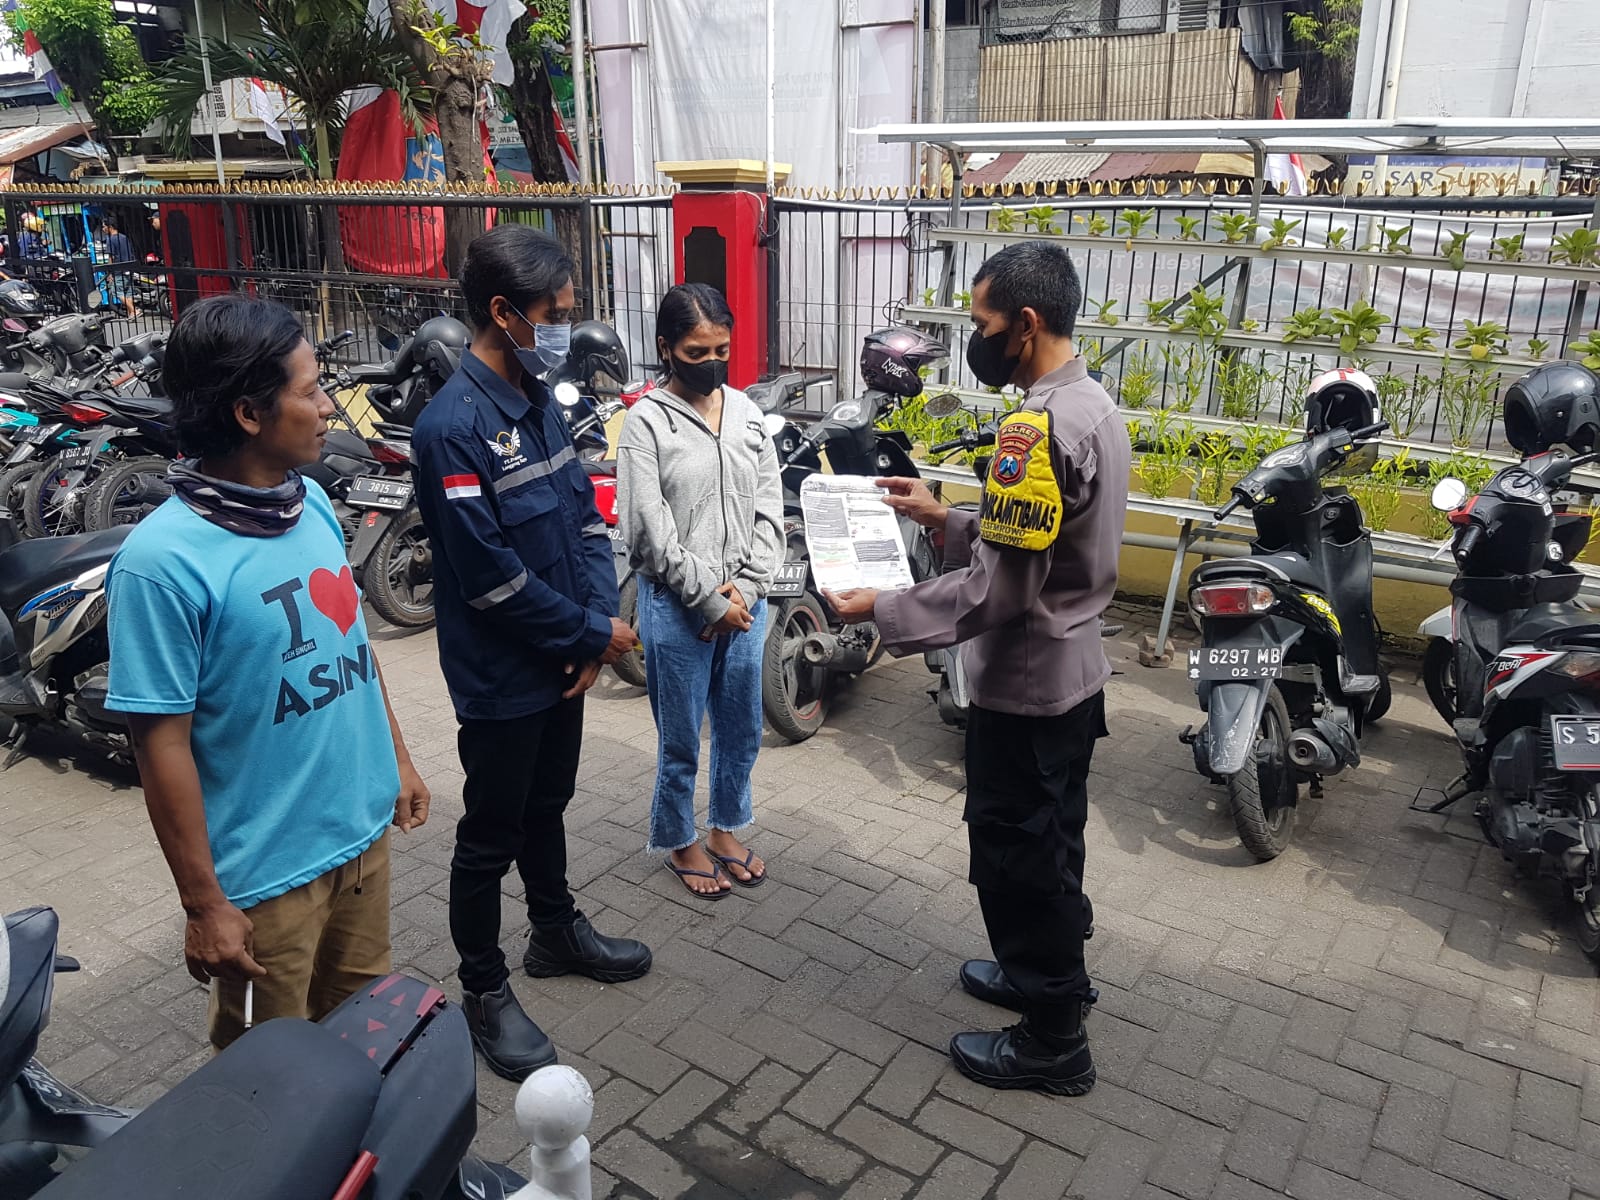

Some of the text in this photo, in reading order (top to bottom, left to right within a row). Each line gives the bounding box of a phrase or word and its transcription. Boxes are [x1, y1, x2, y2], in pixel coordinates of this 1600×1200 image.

[1361, 169, 1434, 188] PSAR
[1001, 426, 1037, 439] POLRES
[1188, 647, 1280, 665] W 6297 MB
[1562, 726, 1575, 744] S
